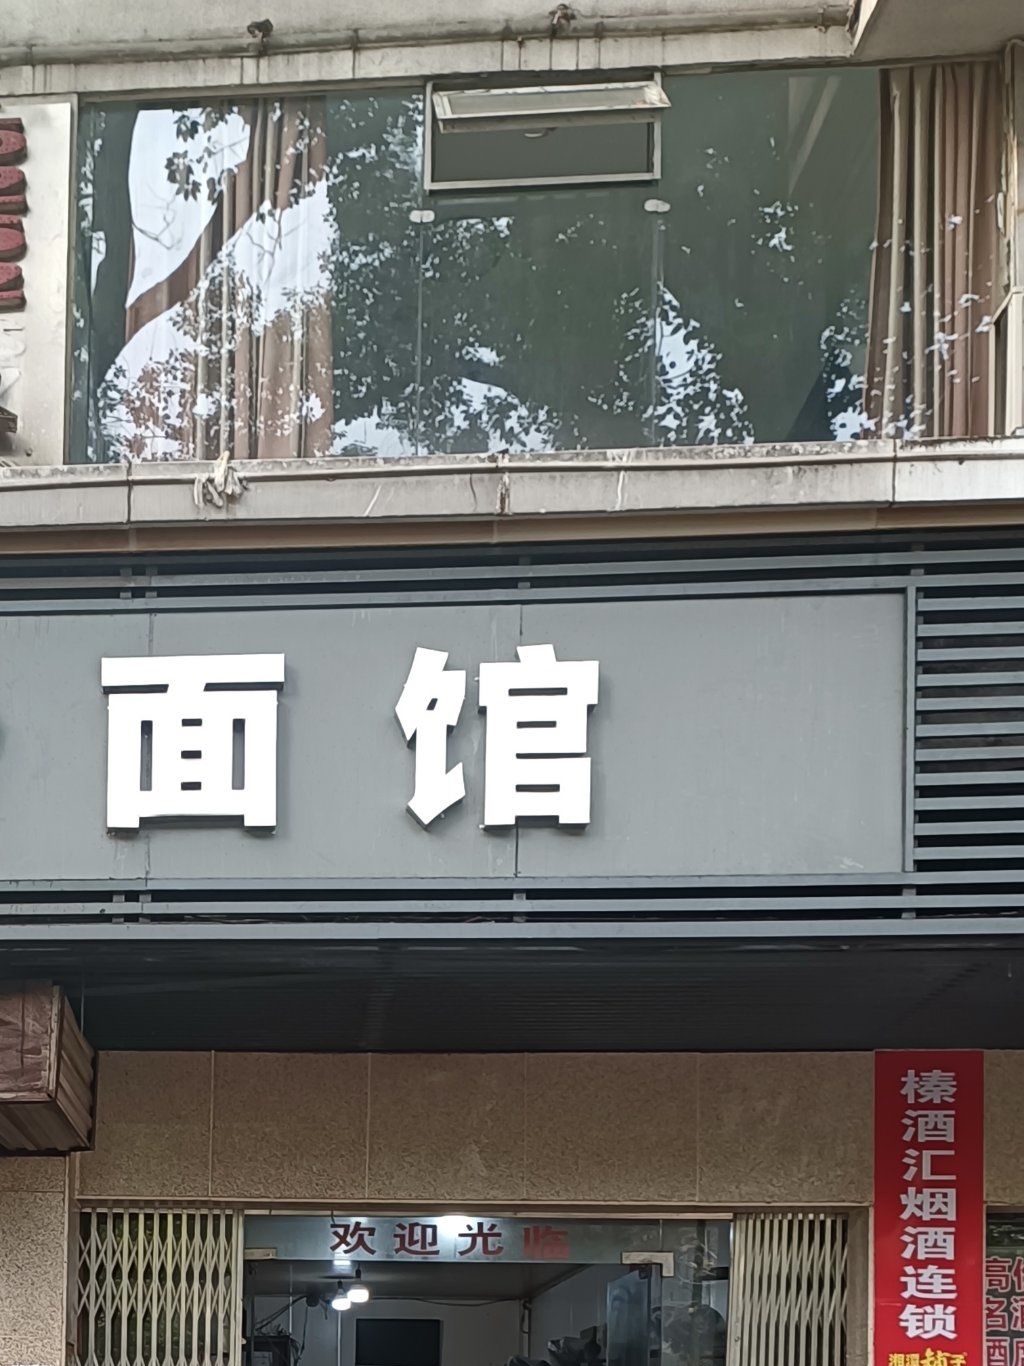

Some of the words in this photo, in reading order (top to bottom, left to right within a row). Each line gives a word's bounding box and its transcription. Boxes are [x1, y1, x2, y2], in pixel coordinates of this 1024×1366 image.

[329, 1221, 571, 1260] 欢迎光临
[899, 1069, 958, 1340] 榛酒汇烟酒连锁
